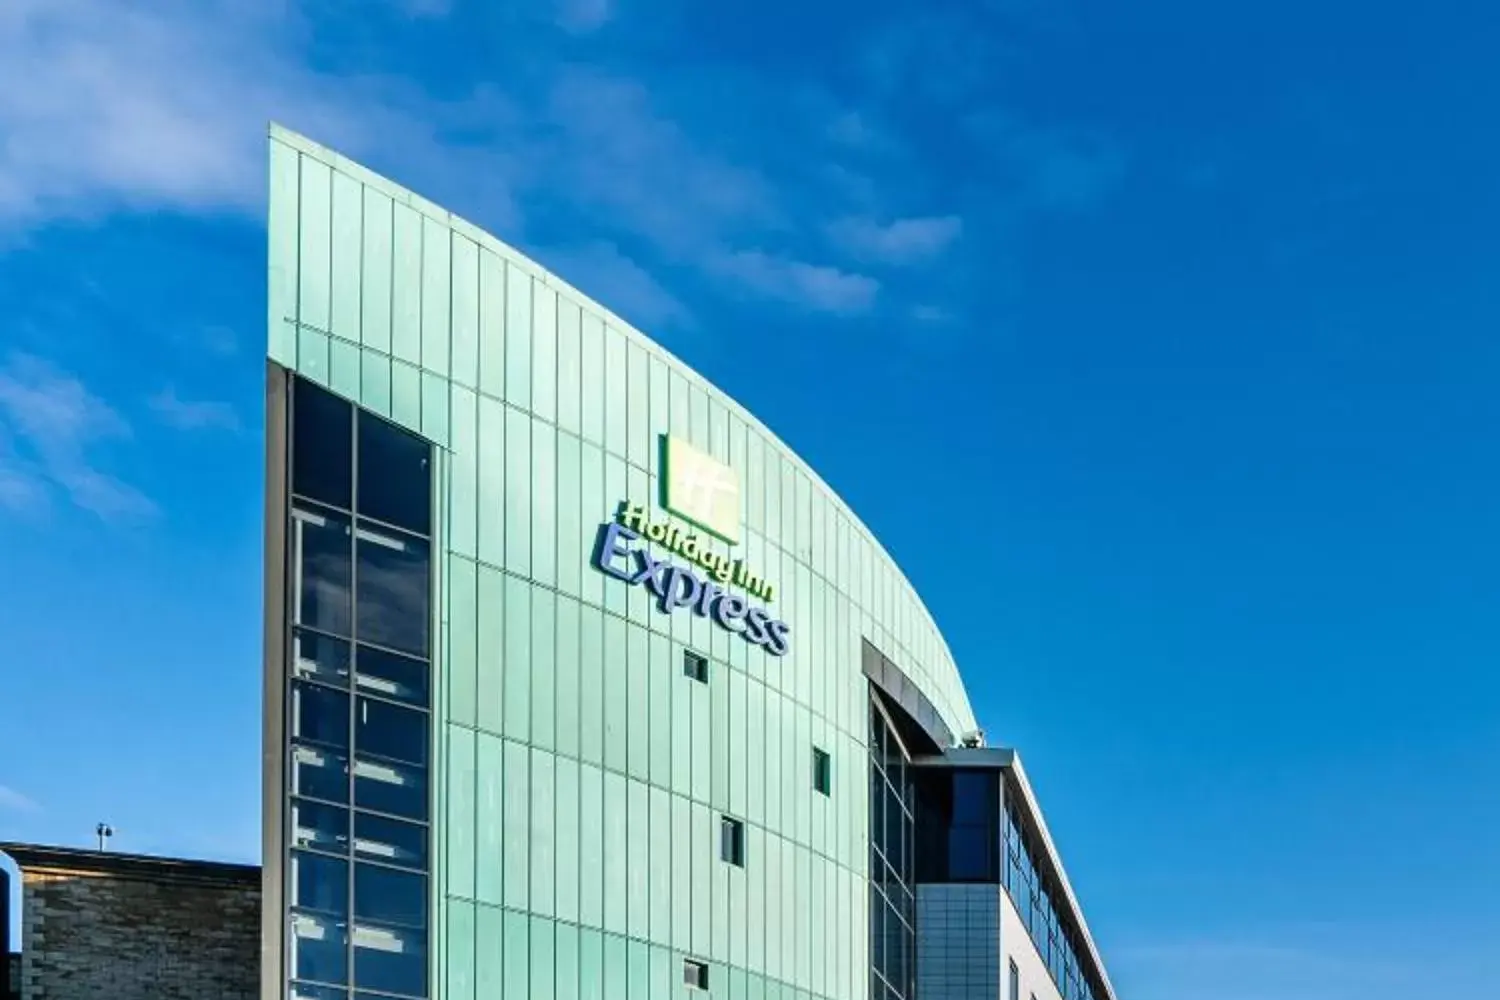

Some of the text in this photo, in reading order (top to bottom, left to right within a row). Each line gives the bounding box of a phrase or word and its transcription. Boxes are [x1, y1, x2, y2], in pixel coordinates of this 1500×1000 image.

[590, 522, 790, 656] Express
[615, 500, 778, 603] Holiday Inn
